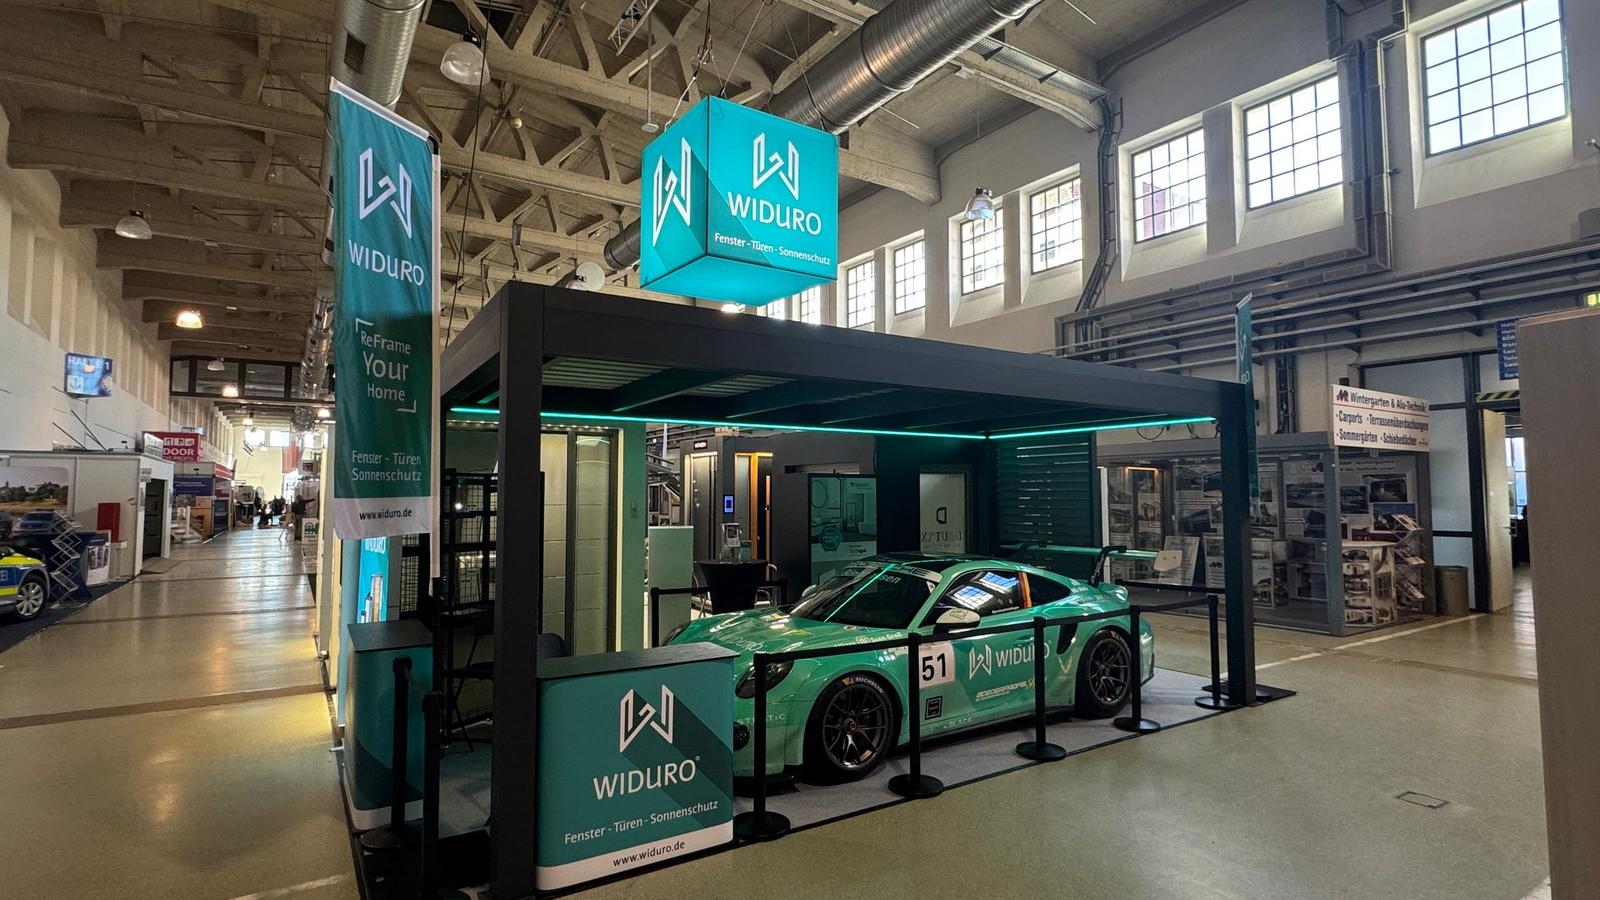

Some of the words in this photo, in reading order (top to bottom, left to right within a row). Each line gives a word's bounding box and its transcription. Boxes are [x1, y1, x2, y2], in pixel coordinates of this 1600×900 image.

[727, 191, 822, 236] WIDURO
[714, 232, 745, 248] Fenster
[751, 239, 774, 253] Türen
[779, 245, 831, 265] Sonnenschutz
[348, 239, 425, 287] WIDURO
[361, 330, 411, 355] ReFrame
[363, 351, 409, 381] Your
[367, 383, 406, 401] Home
[163, 448, 194, 456] DOOR
[351, 450, 382, 464] Fenster
[393, 452, 421, 465] Türen
[351, 467, 422, 482] Sonnenschutz
[359, 507, 413, 521] www.widuro.de
[922, 652, 946, 681] 51
[995, 641, 1050, 669] WIDUO
[592, 758, 696, 800] WIDURO
[564, 827, 606, 846] Fenster
[613, 817, 643, 833] Türen
[650, 800, 719, 824] Sonnenschutz
[612, 839, 686, 867] www.widuro.de
